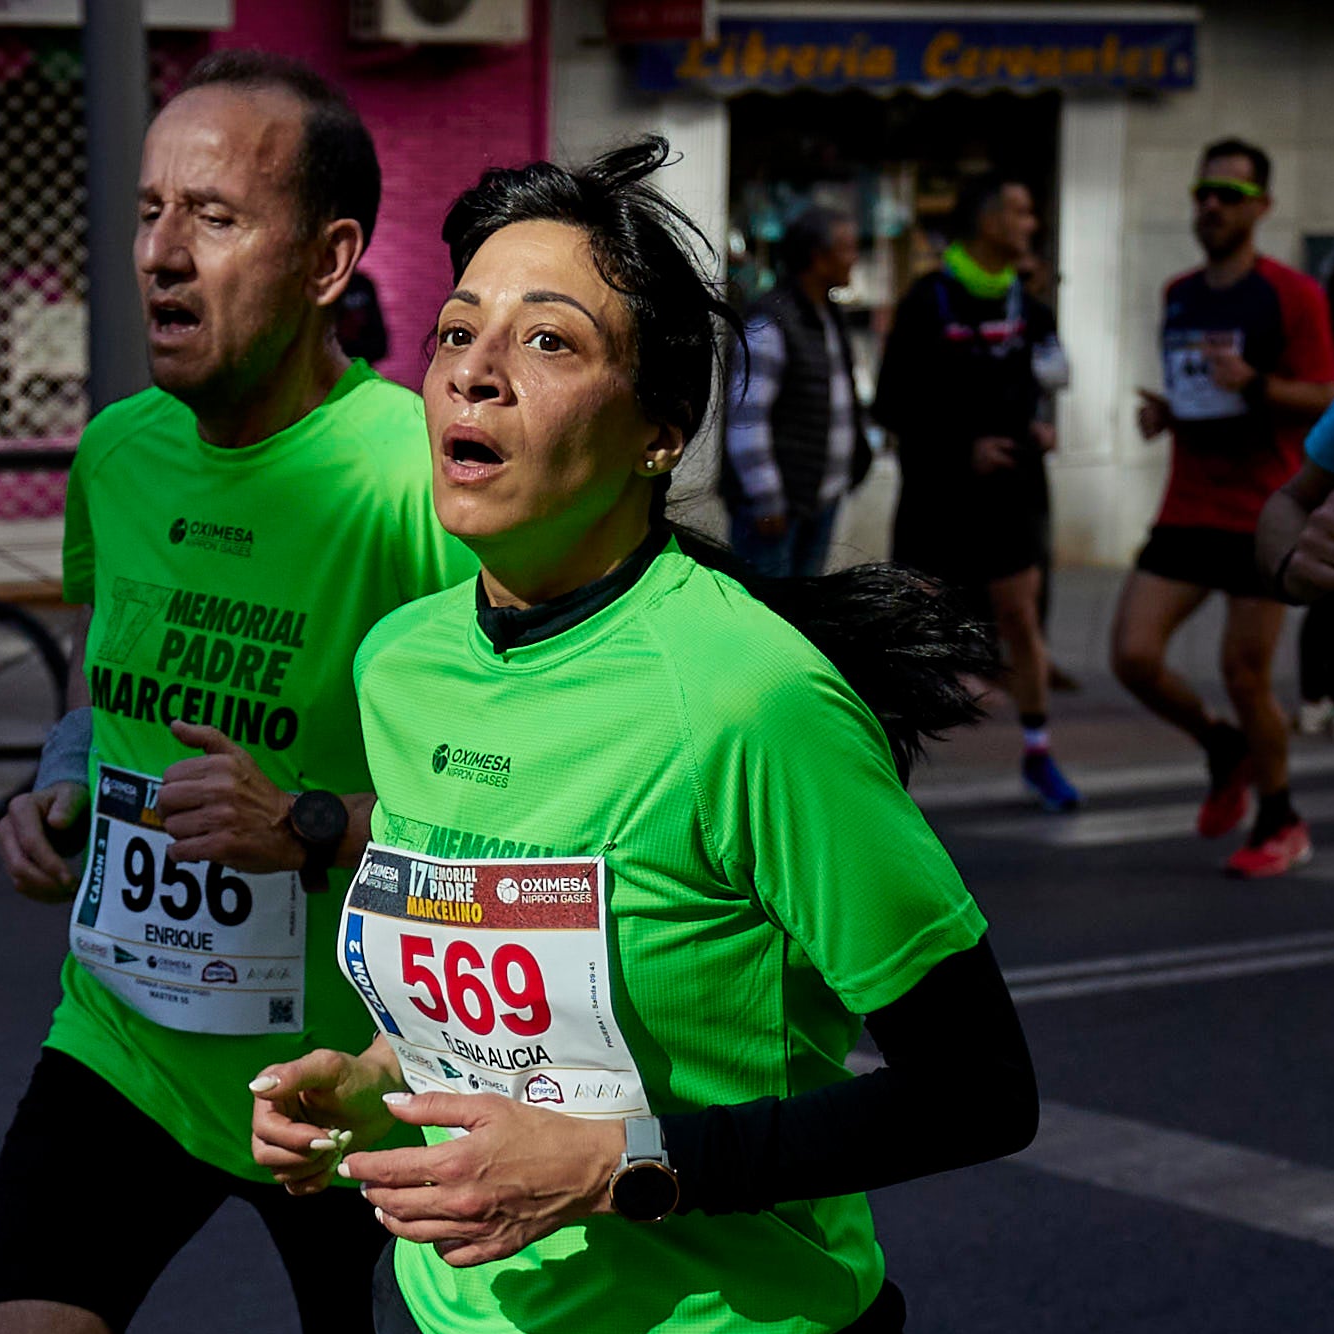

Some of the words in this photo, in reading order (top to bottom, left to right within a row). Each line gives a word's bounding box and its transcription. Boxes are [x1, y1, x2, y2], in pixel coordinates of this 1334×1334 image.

[189, 521, 254, 545] OXIMESA
[164, 589, 307, 648] MEMORIAL
[156, 628, 292, 697] PADRE
[452, 748, 512, 774] OXIMESA
[475, 772, 509, 789] GASES
[122, 837, 252, 926] 956
[409, 861, 429, 898] 17
[428, 864, 478, 883] MEMORIAL
[429, 880, 475, 903] PADRE
[520, 877, 592, 892] OXIMESA
[407, 895, 484, 924] MARCELINO
[521, 894, 558, 905] NIPPON
[560, 893, 593, 904] GASES
[145, 924, 214, 951] ENRIQUE
[349, 939, 362, 955] 2
[400, 933, 552, 1036] 569
